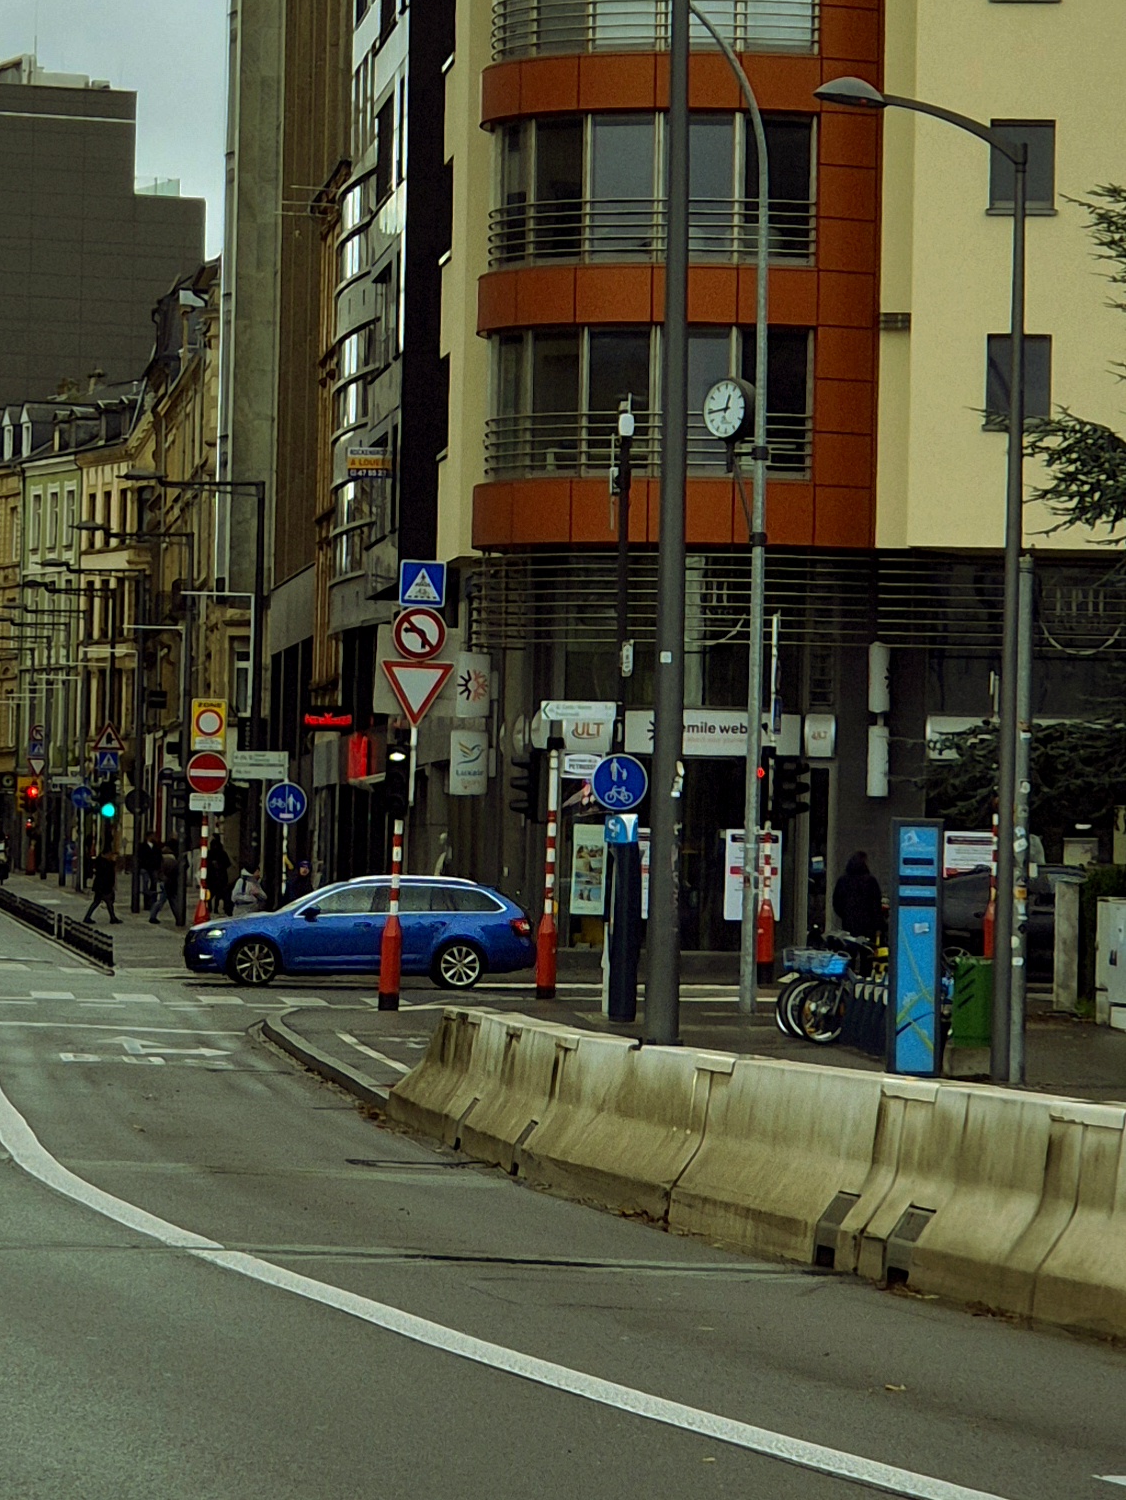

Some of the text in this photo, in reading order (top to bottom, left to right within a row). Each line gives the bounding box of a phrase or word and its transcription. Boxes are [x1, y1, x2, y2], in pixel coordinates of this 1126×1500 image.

[574, 722, 605, 737] ULT
[683, 721, 748, 734] mile web
